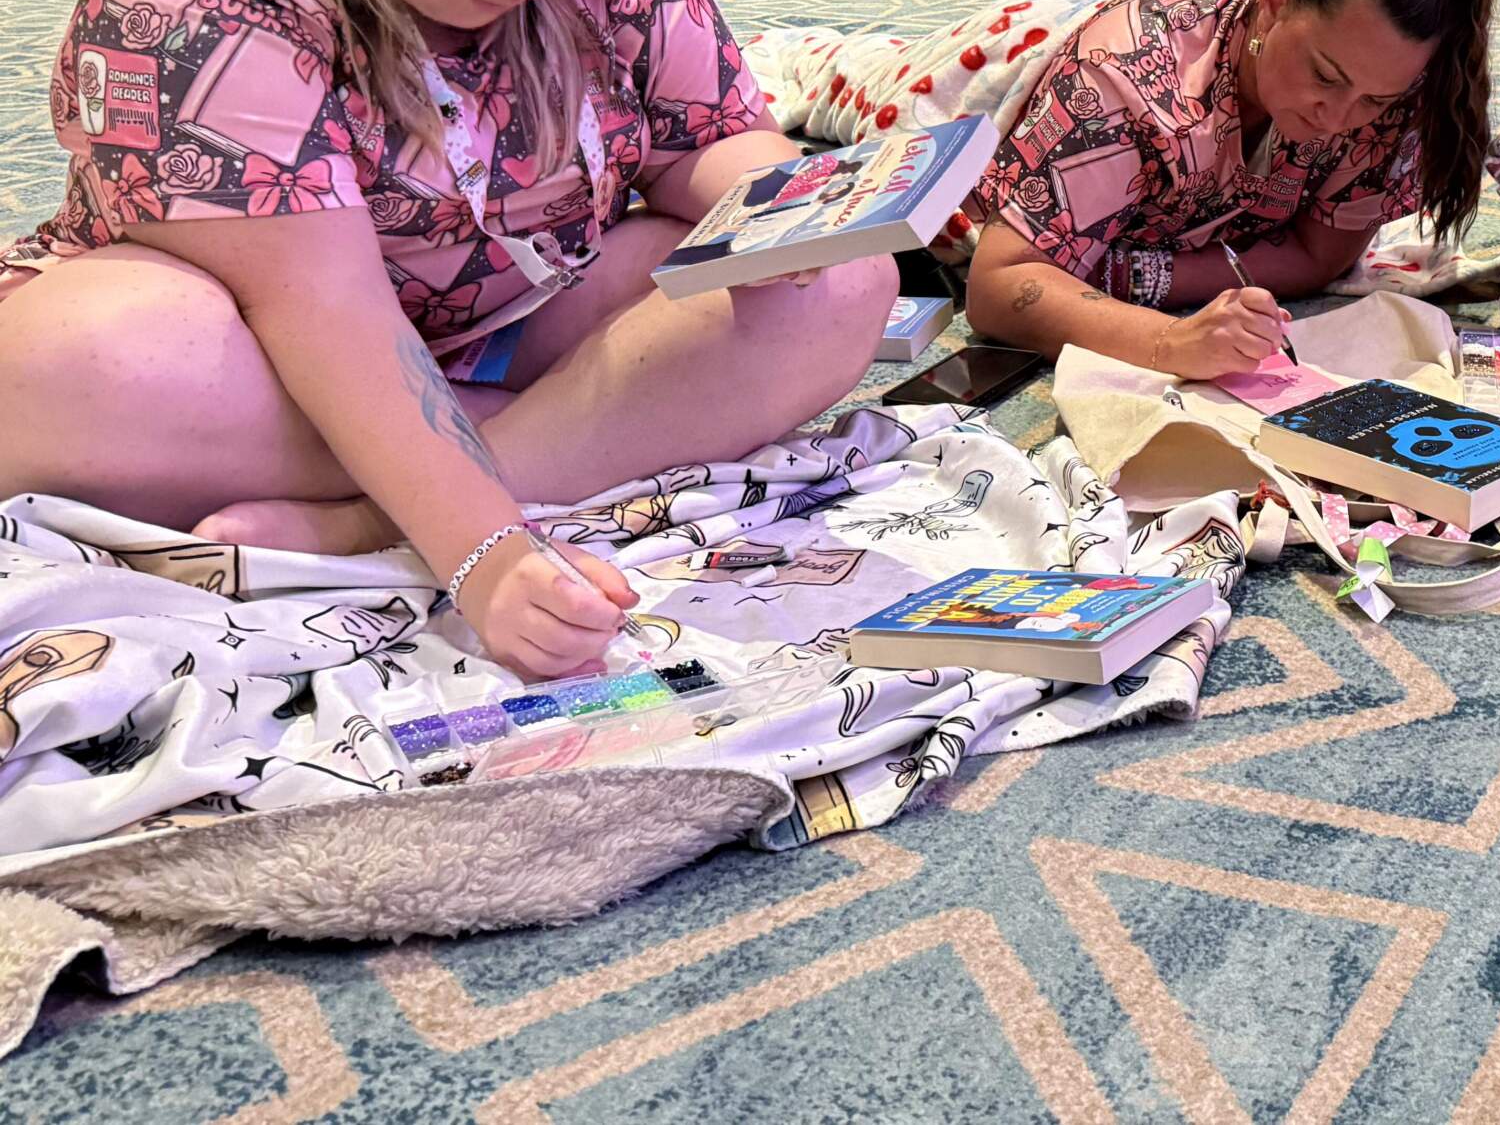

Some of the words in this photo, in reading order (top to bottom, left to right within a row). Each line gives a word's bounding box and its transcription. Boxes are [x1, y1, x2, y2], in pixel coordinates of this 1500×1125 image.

[107, 69, 157, 88] ROMANCE
[111, 85, 152, 104] READER
[1347, 424, 1385, 441] ALLEN
[1009, 590, 1055, 606] TO
